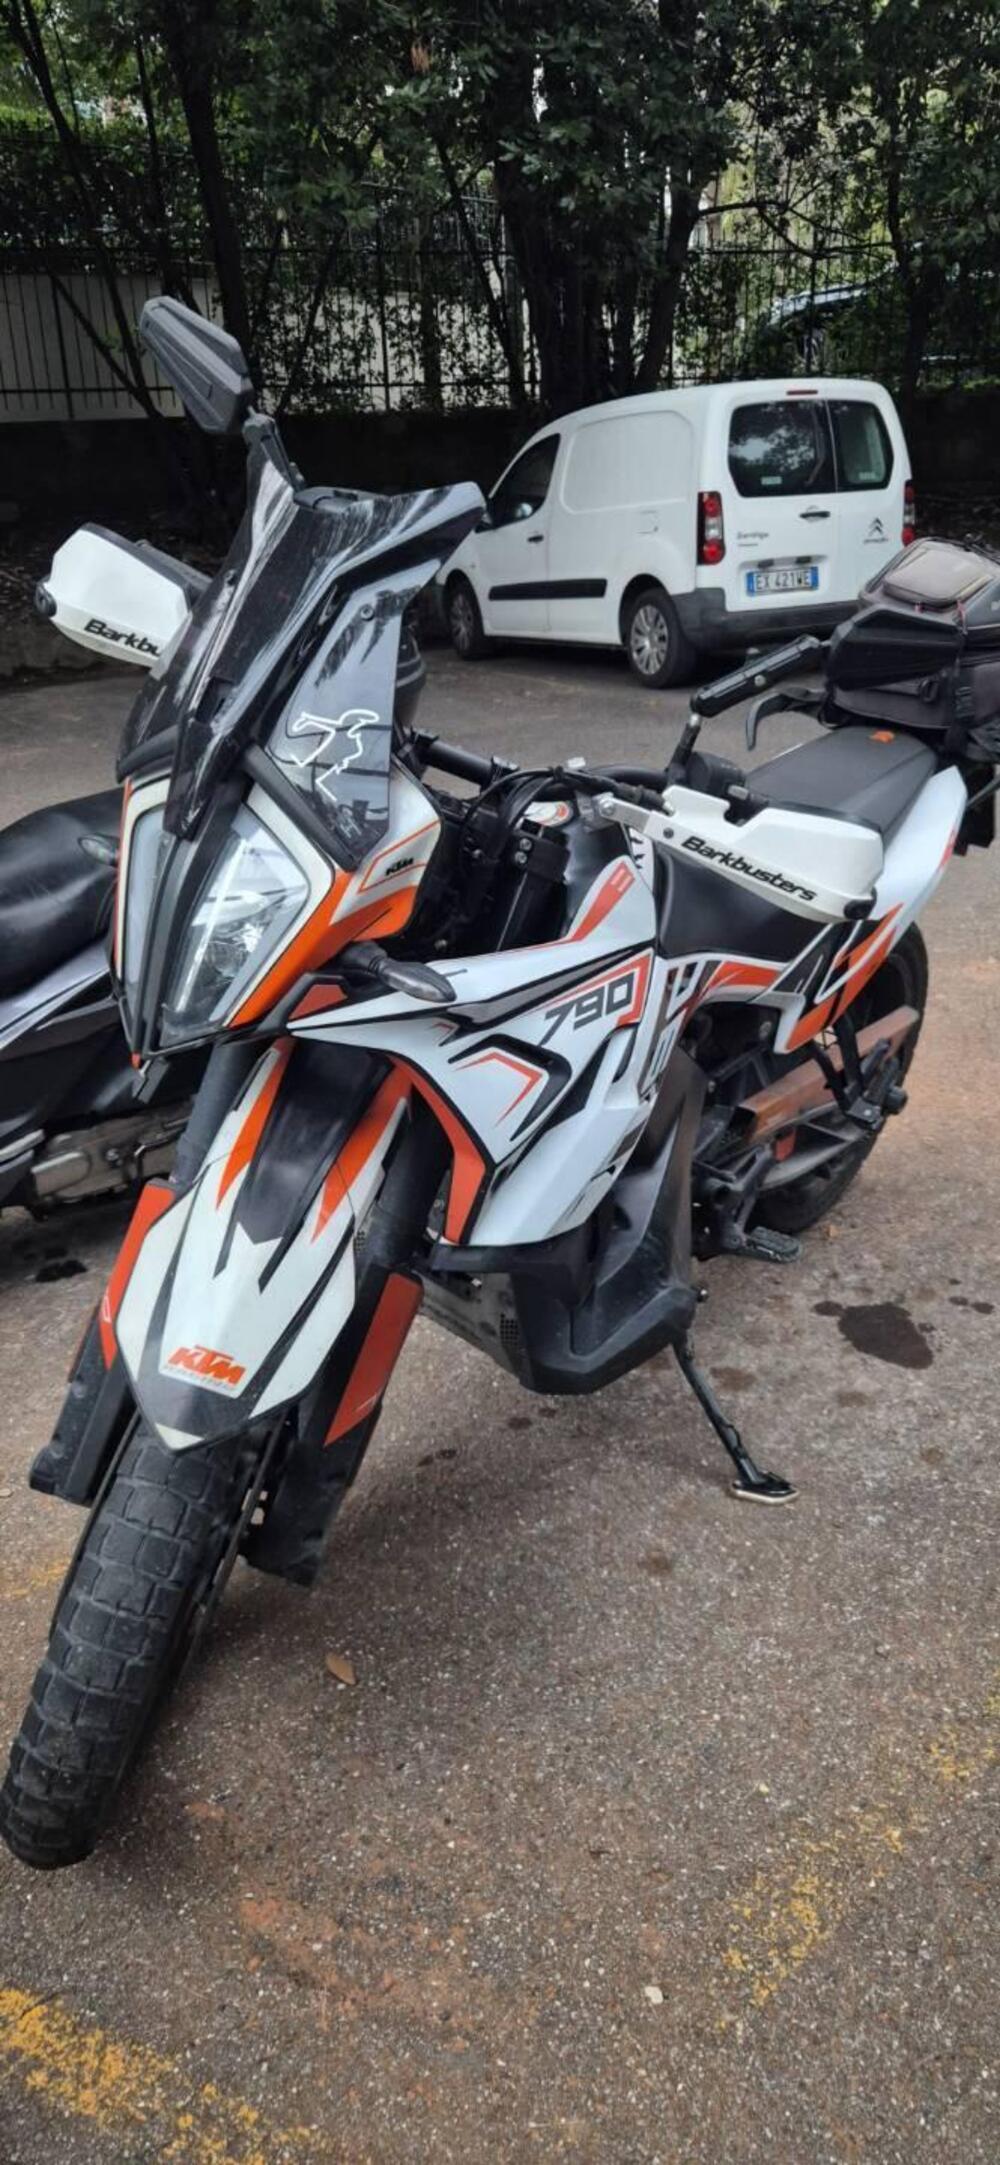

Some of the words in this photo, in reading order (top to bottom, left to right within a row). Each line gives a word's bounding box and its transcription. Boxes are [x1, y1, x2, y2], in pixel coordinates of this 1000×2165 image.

[756, 574, 769, 590] EX
[681, 836, 817, 901] Barkbusters
[538, 971, 635, 1046] 790
[167, 1344, 246, 1385] KTM
